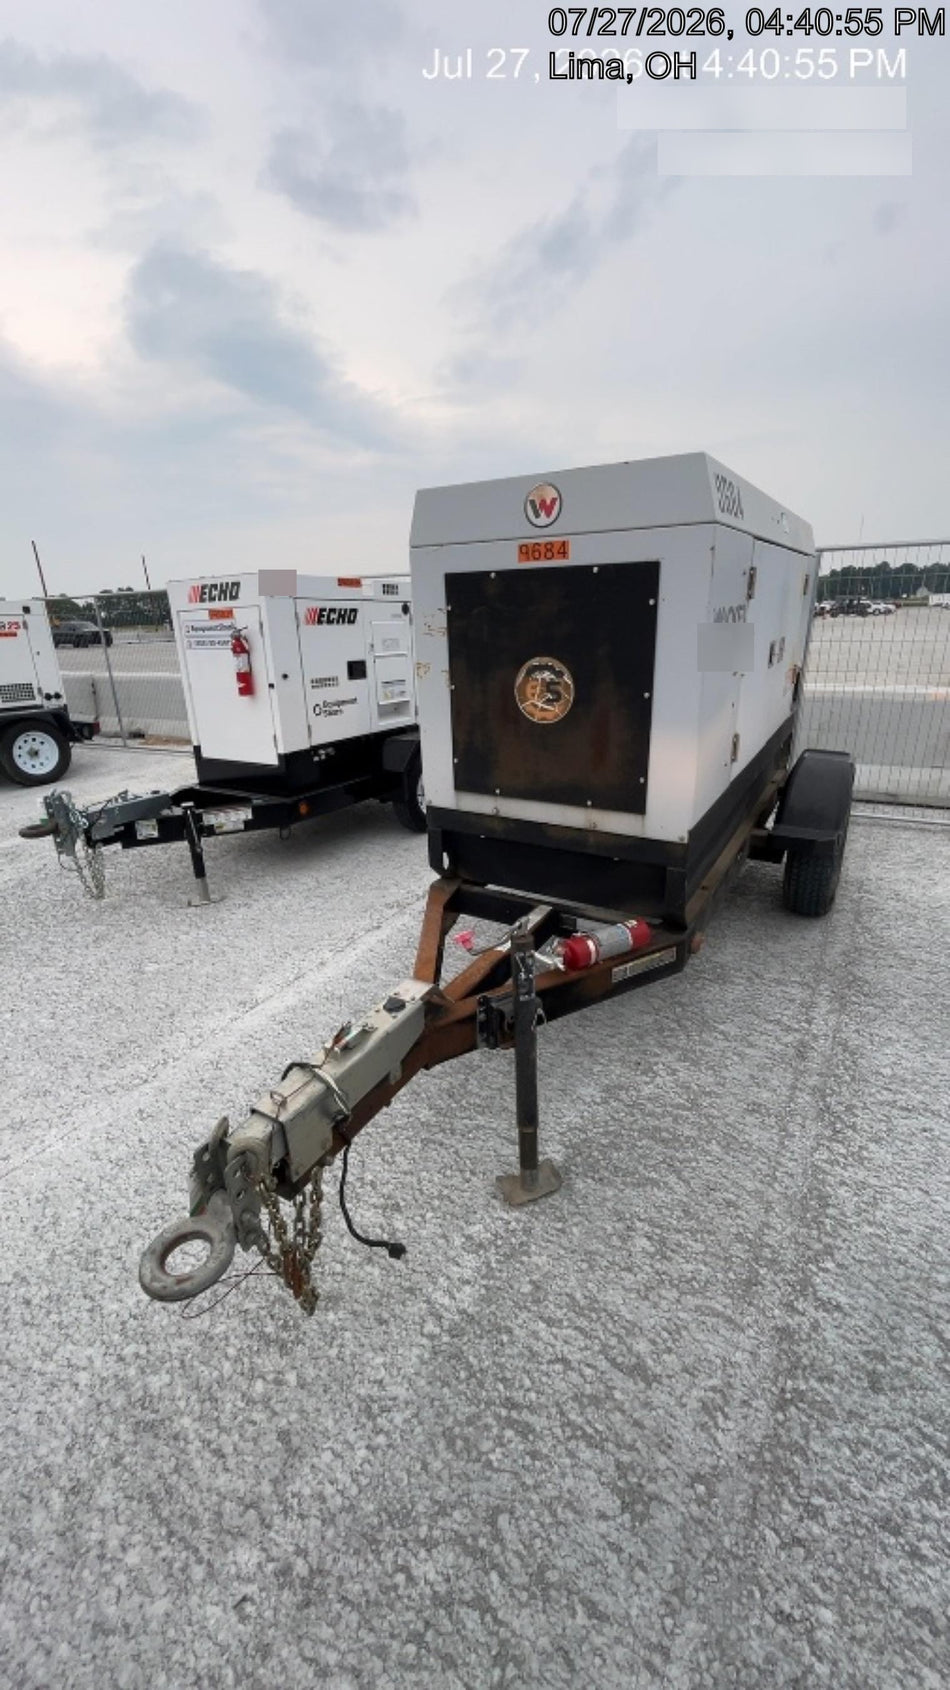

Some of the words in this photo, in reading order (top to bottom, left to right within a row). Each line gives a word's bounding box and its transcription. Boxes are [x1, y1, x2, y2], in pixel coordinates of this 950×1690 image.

[529, 496, 558, 520] W
[519, 540, 569, 562] 9684
[199, 581, 241, 603] ECHO
[317, 607, 358, 626] ECHO
